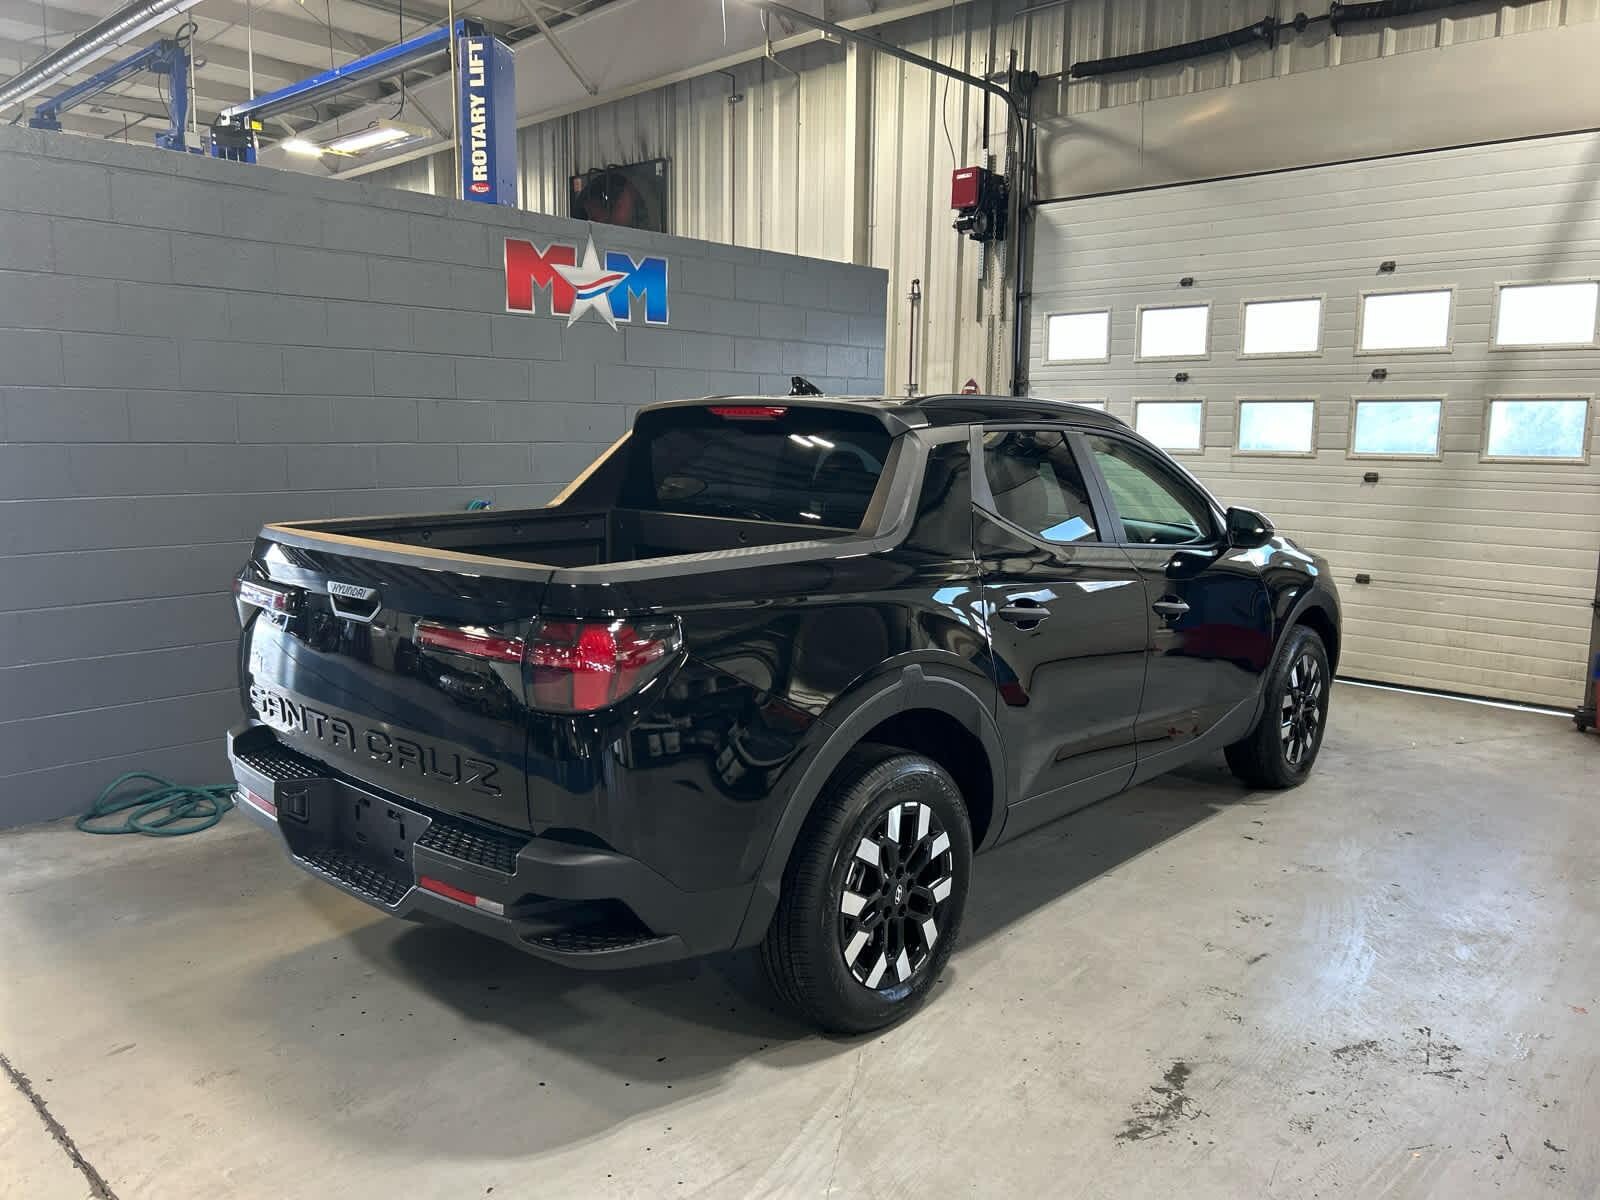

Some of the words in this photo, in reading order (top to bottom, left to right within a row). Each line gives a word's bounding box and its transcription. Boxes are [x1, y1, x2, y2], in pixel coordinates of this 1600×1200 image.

[468, 40, 485, 87] LIFT
[470, 93, 487, 181] ROTARY
[331, 583, 368, 599] HYUNDAI
[249, 684, 357, 753] SANTA
[363, 729, 503, 798] CRUZ
